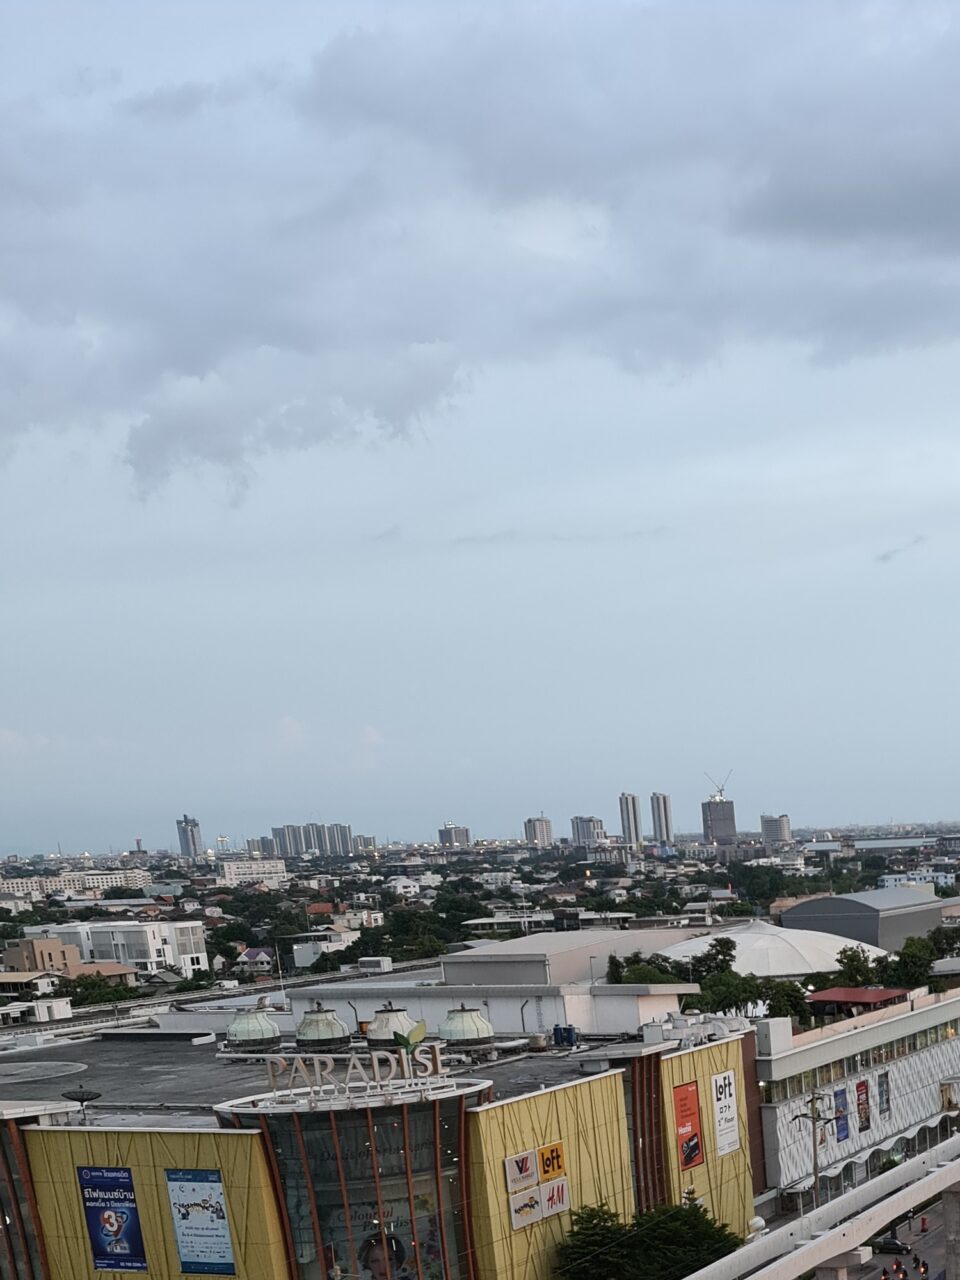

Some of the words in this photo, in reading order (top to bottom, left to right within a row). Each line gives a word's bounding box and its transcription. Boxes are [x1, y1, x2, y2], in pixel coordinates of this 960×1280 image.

[265, 1042, 450, 1089] PARADISE
[715, 1075, 733, 1102] Loft
[541, 1147, 562, 1175] Loft
[547, 1183, 564, 1210] H&M
[103, 1210, 118, 1232] 3
